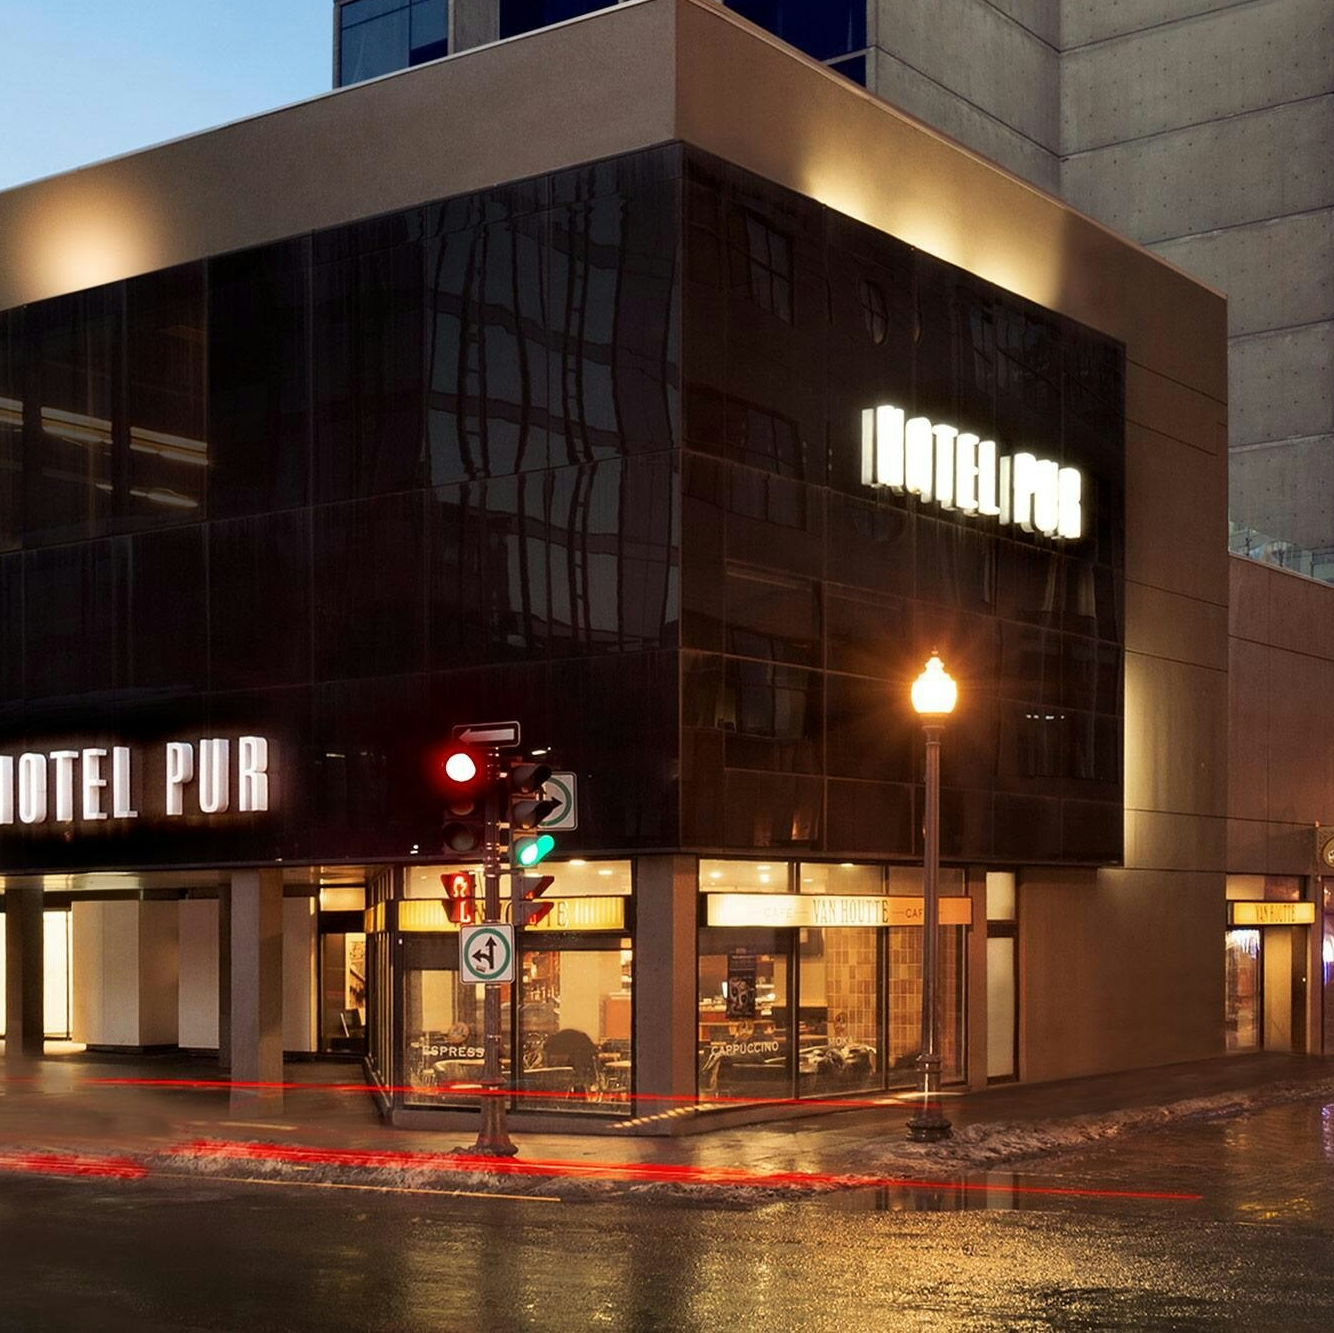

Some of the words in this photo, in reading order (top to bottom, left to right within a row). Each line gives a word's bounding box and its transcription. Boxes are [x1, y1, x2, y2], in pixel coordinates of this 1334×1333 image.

[166, 735, 269, 816] PUR
[813, 899, 836, 924] VAN
[841, 899, 889, 924] HOUTTE
[905, 908, 924, 919] CAF
[423, 1046, 485, 1058] ESPRESS
[711, 1041, 779, 1056] CAPPUCCINO
